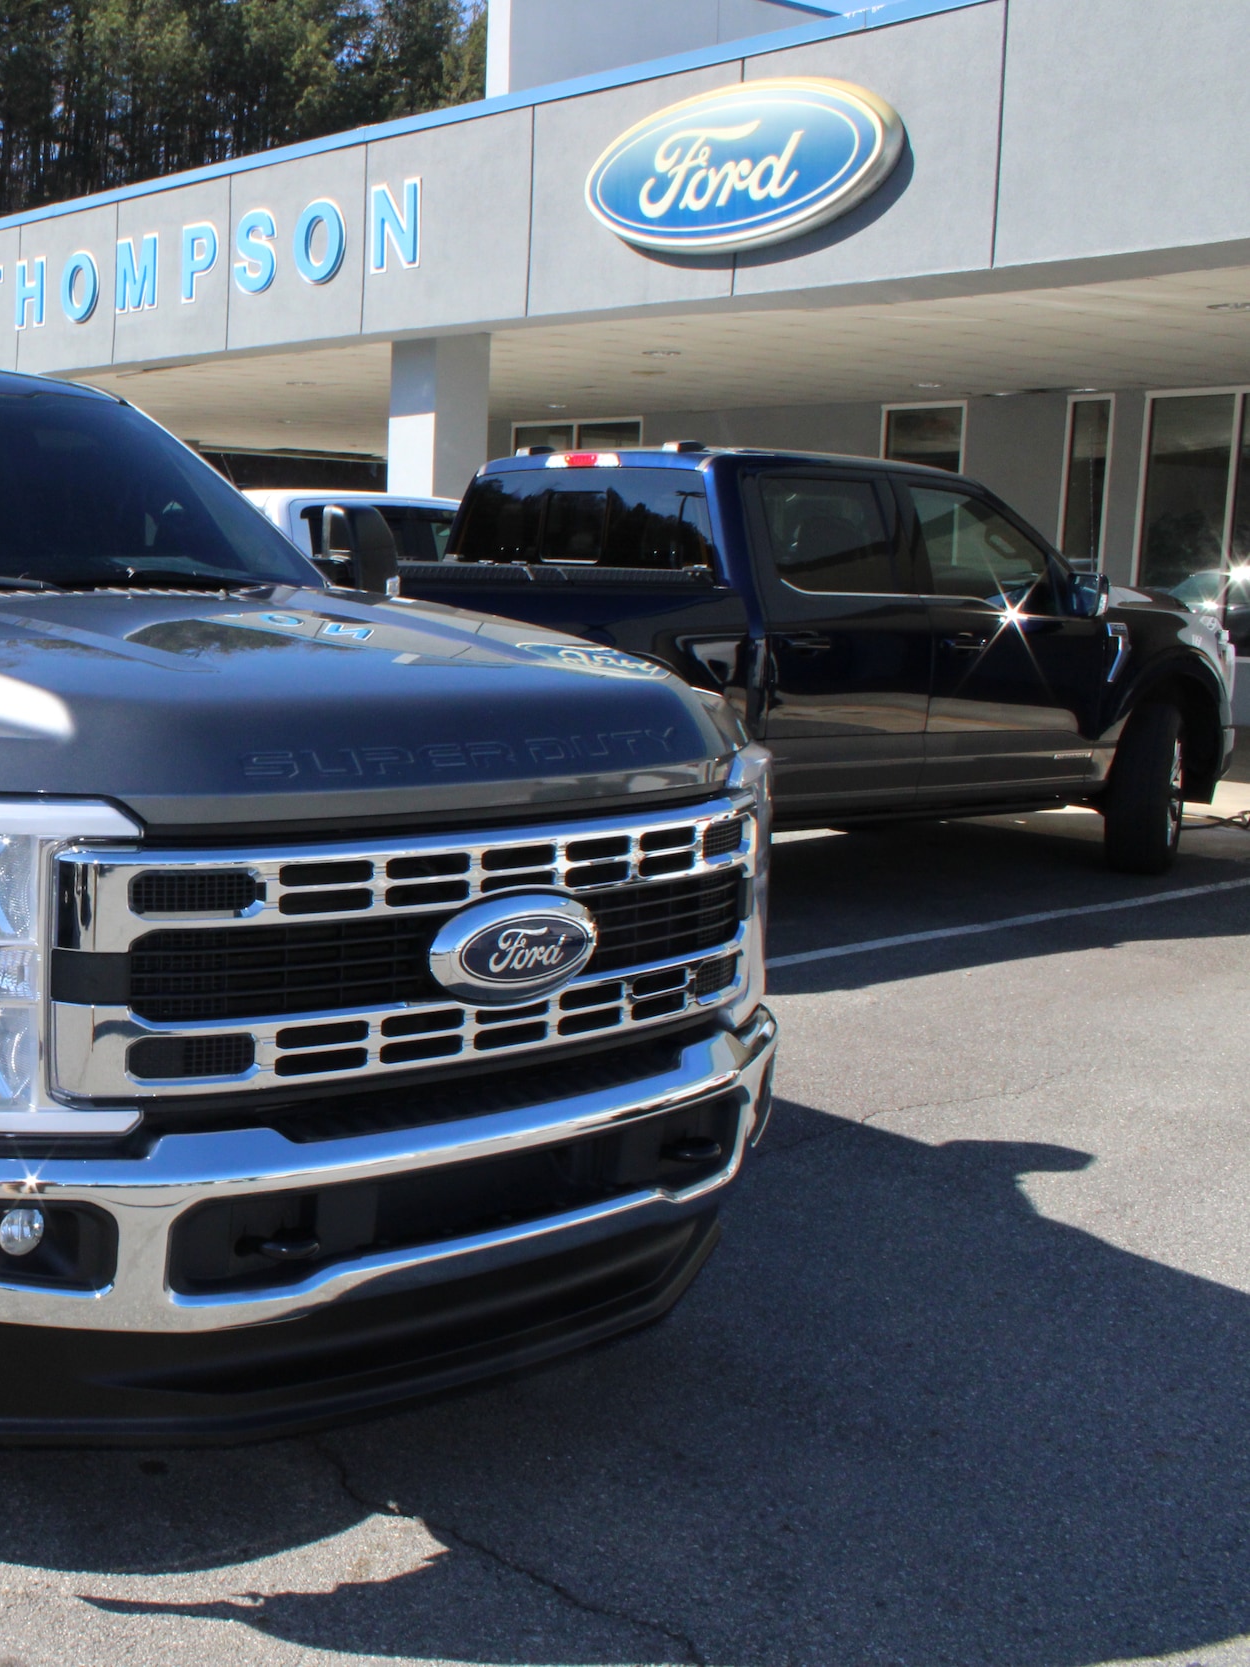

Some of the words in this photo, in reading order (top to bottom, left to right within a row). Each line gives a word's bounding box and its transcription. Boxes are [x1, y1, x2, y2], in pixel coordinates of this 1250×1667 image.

[638, 119, 805, 219] Ford
[243, 740, 516, 779] SUPER
[524, 726, 673, 764] DUTY
[488, 926, 567, 974] Ford
